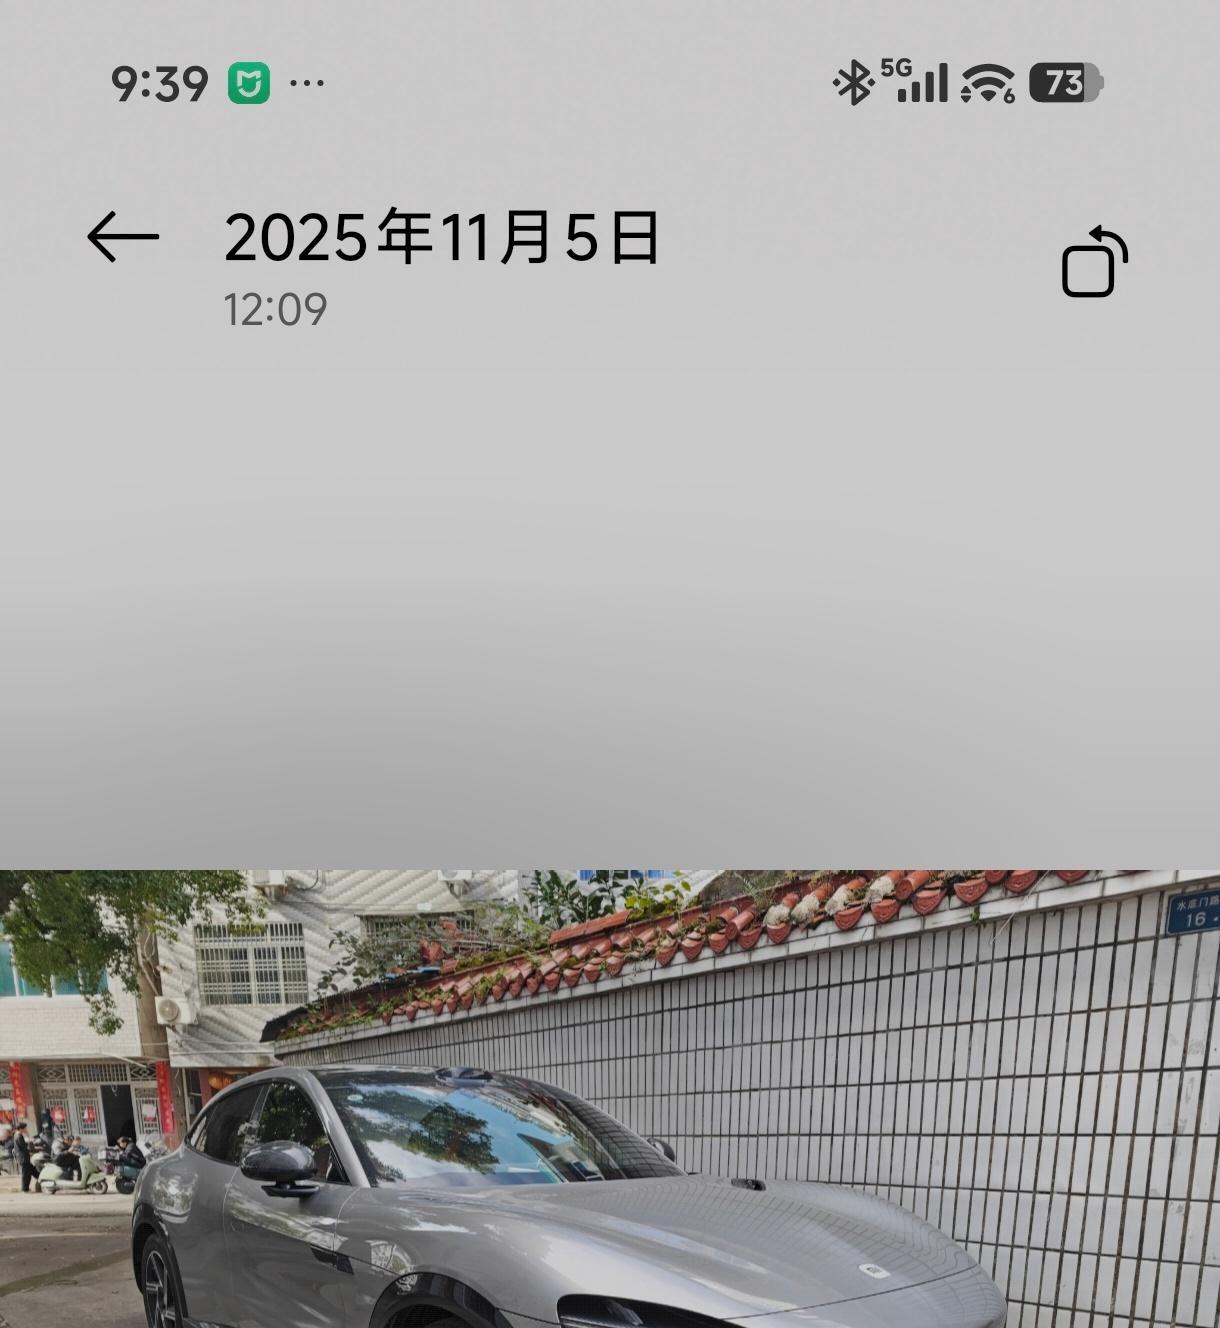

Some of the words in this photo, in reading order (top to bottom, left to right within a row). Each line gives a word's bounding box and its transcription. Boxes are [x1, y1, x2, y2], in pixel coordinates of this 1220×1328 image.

[111, 66, 209, 103] 9:39
[880, 58, 913, 77] 5G
[1046, 70, 1083, 96] 73
[225, 207, 658, 265] 2025年11月5日
[224, 291, 328, 327] 12:09
